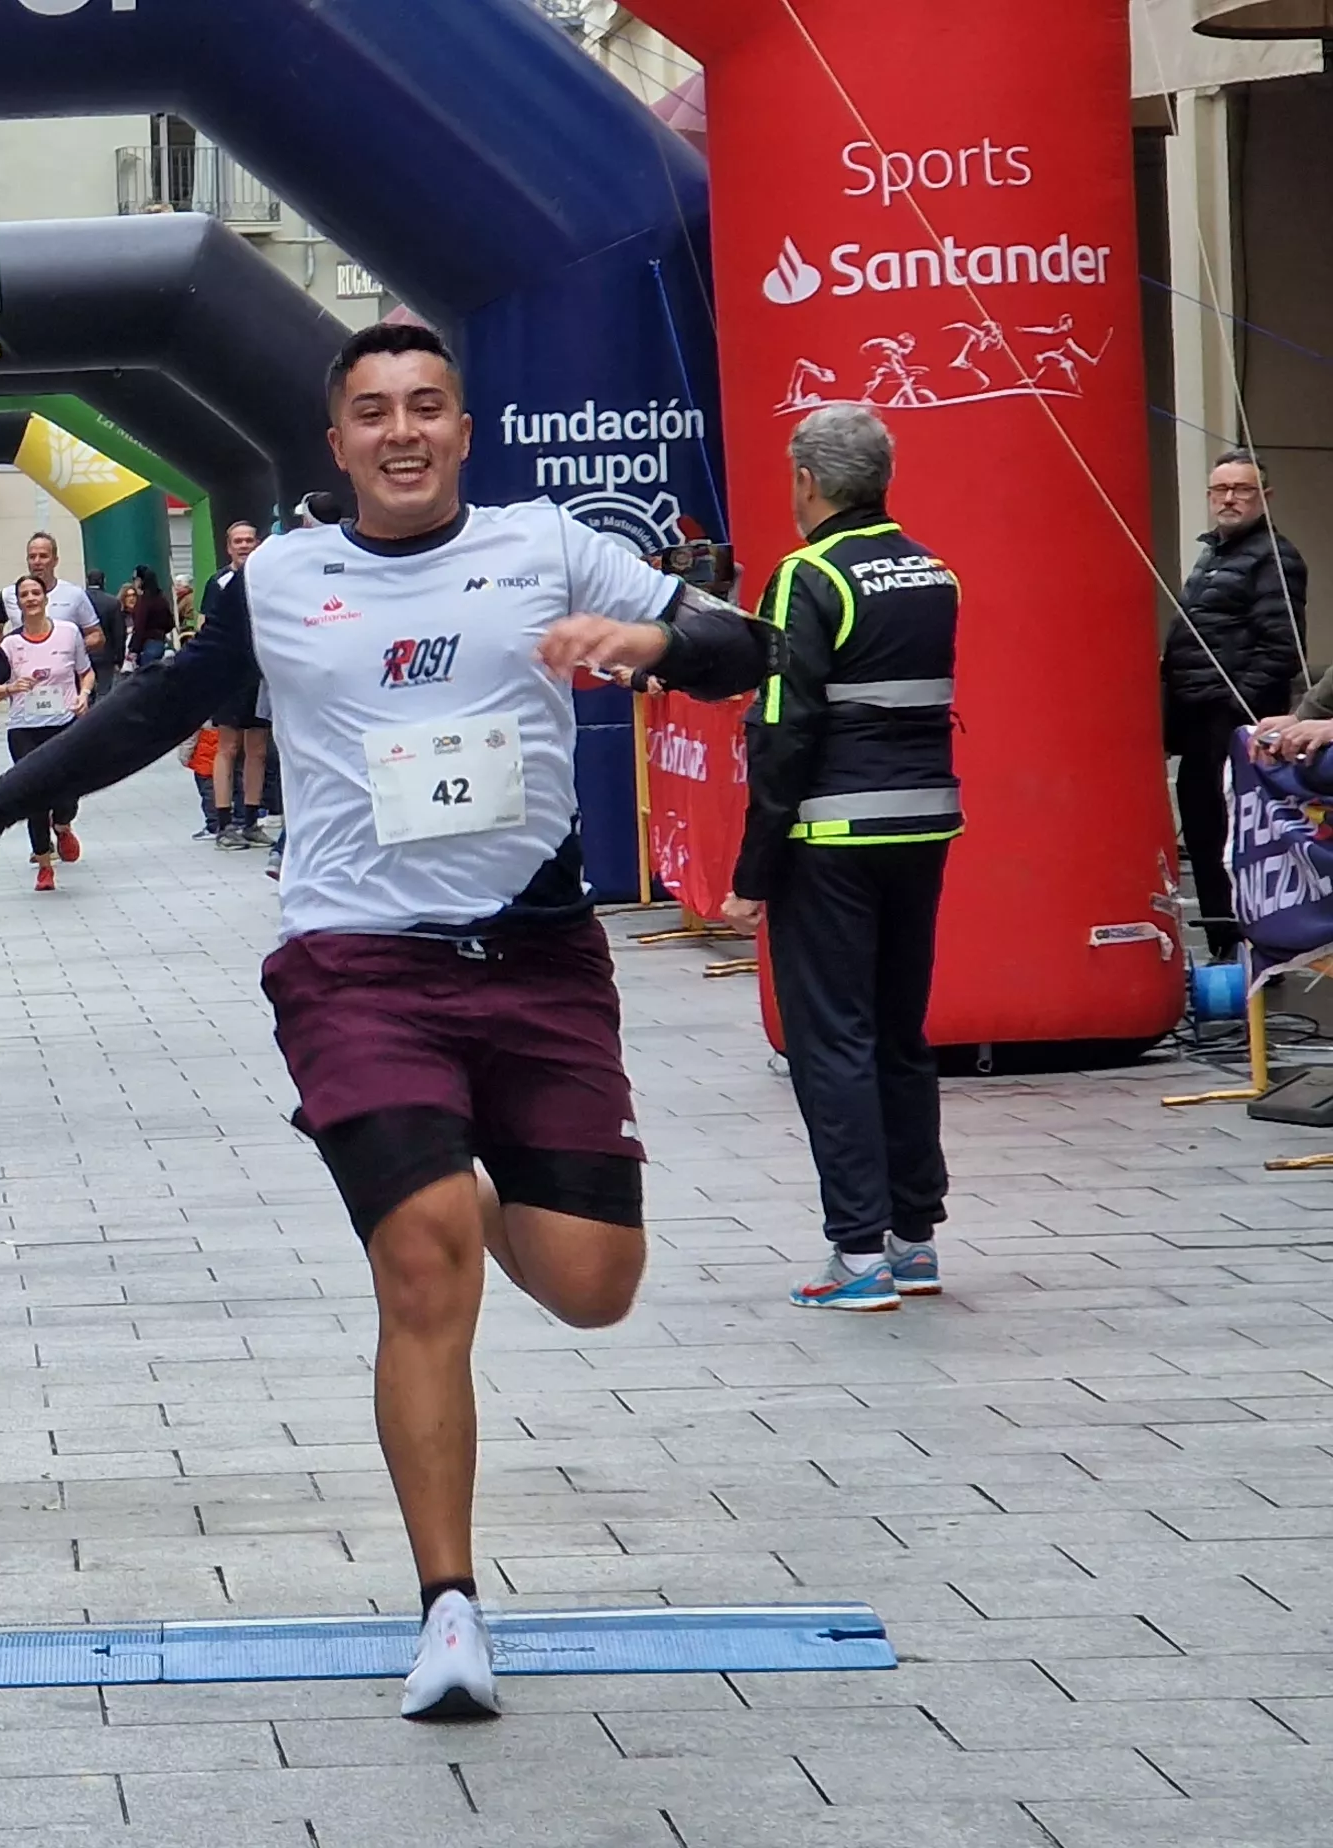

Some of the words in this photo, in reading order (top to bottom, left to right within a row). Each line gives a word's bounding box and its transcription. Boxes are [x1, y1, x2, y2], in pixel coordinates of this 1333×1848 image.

[841, 137, 1032, 206] Sports
[830, 233, 1110, 296] Santander
[501, 398, 705, 445] fundación
[536, 442, 668, 493] mupol
[497, 574, 541, 589] mupol
[431, 778, 473, 806] 42
